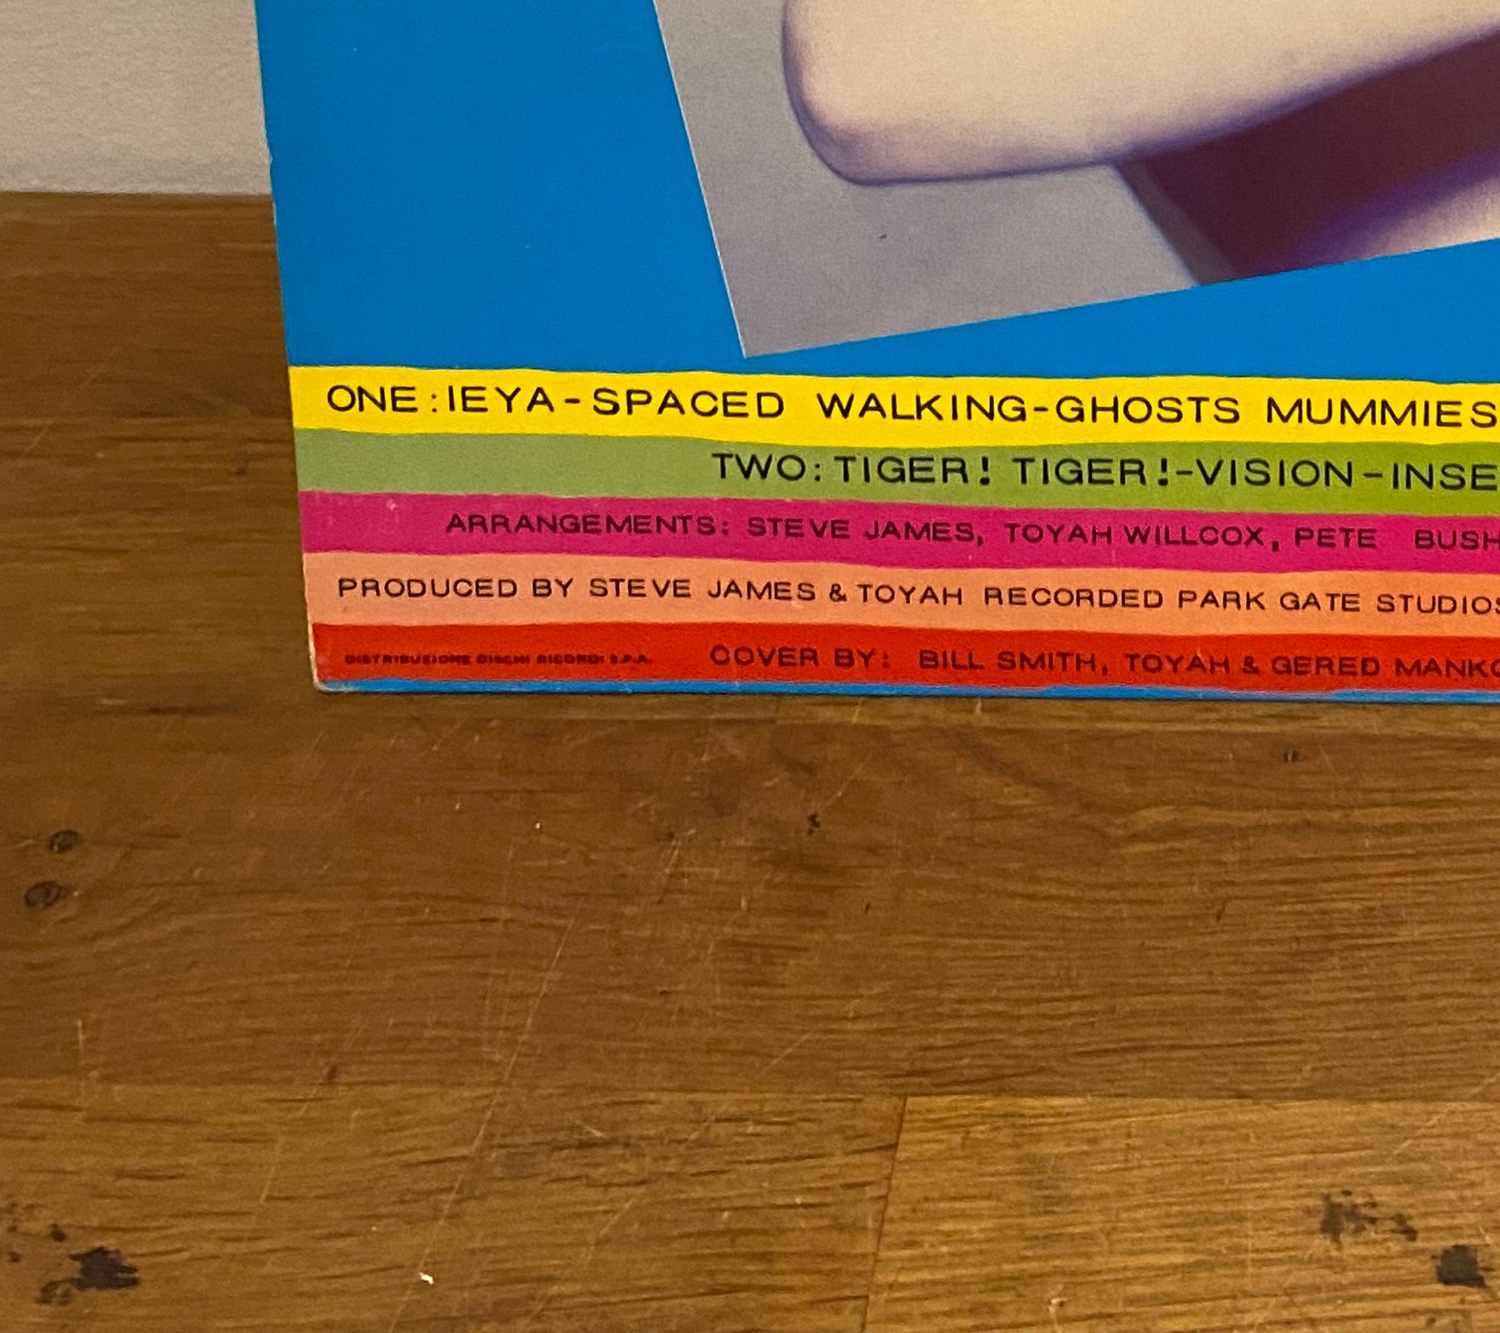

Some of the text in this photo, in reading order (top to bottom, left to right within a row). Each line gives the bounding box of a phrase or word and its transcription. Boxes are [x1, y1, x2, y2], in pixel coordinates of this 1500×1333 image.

[445, 512, 731, 537] ARRANGEMENTS:
[746, 516, 852, 539] STEVE
[864, 519, 985, 547] JAMES,
[1003, 522, 1113, 545] TOYAH
[1122, 524, 1281, 552] WILLCOX,
[1294, 528, 1378, 550] PETE
[338, 578, 519, 600] PRODUCED
[533, 577, 573, 599] BY
[589, 578, 692, 600] STEVE
[707, 581, 816, 602] JAMES
[830, 583, 847, 603] &
[857, 583, 963, 606] TOYAH
[984, 587, 1163, 609] RECORDED
[1178, 590, 1266, 611] PARK
[1279, 592, 1361, 613] GATE
[709, 644, 820, 667] COVER
[833, 647, 891, 669] BY:
[918, 649, 985, 670] BILL
[997, 651, 1109, 676] SMITH,
[1125, 653, 1231, 674] TOYAH
[1241, 655, 1260, 675] &
[1270, 656, 1381, 677] GERED
